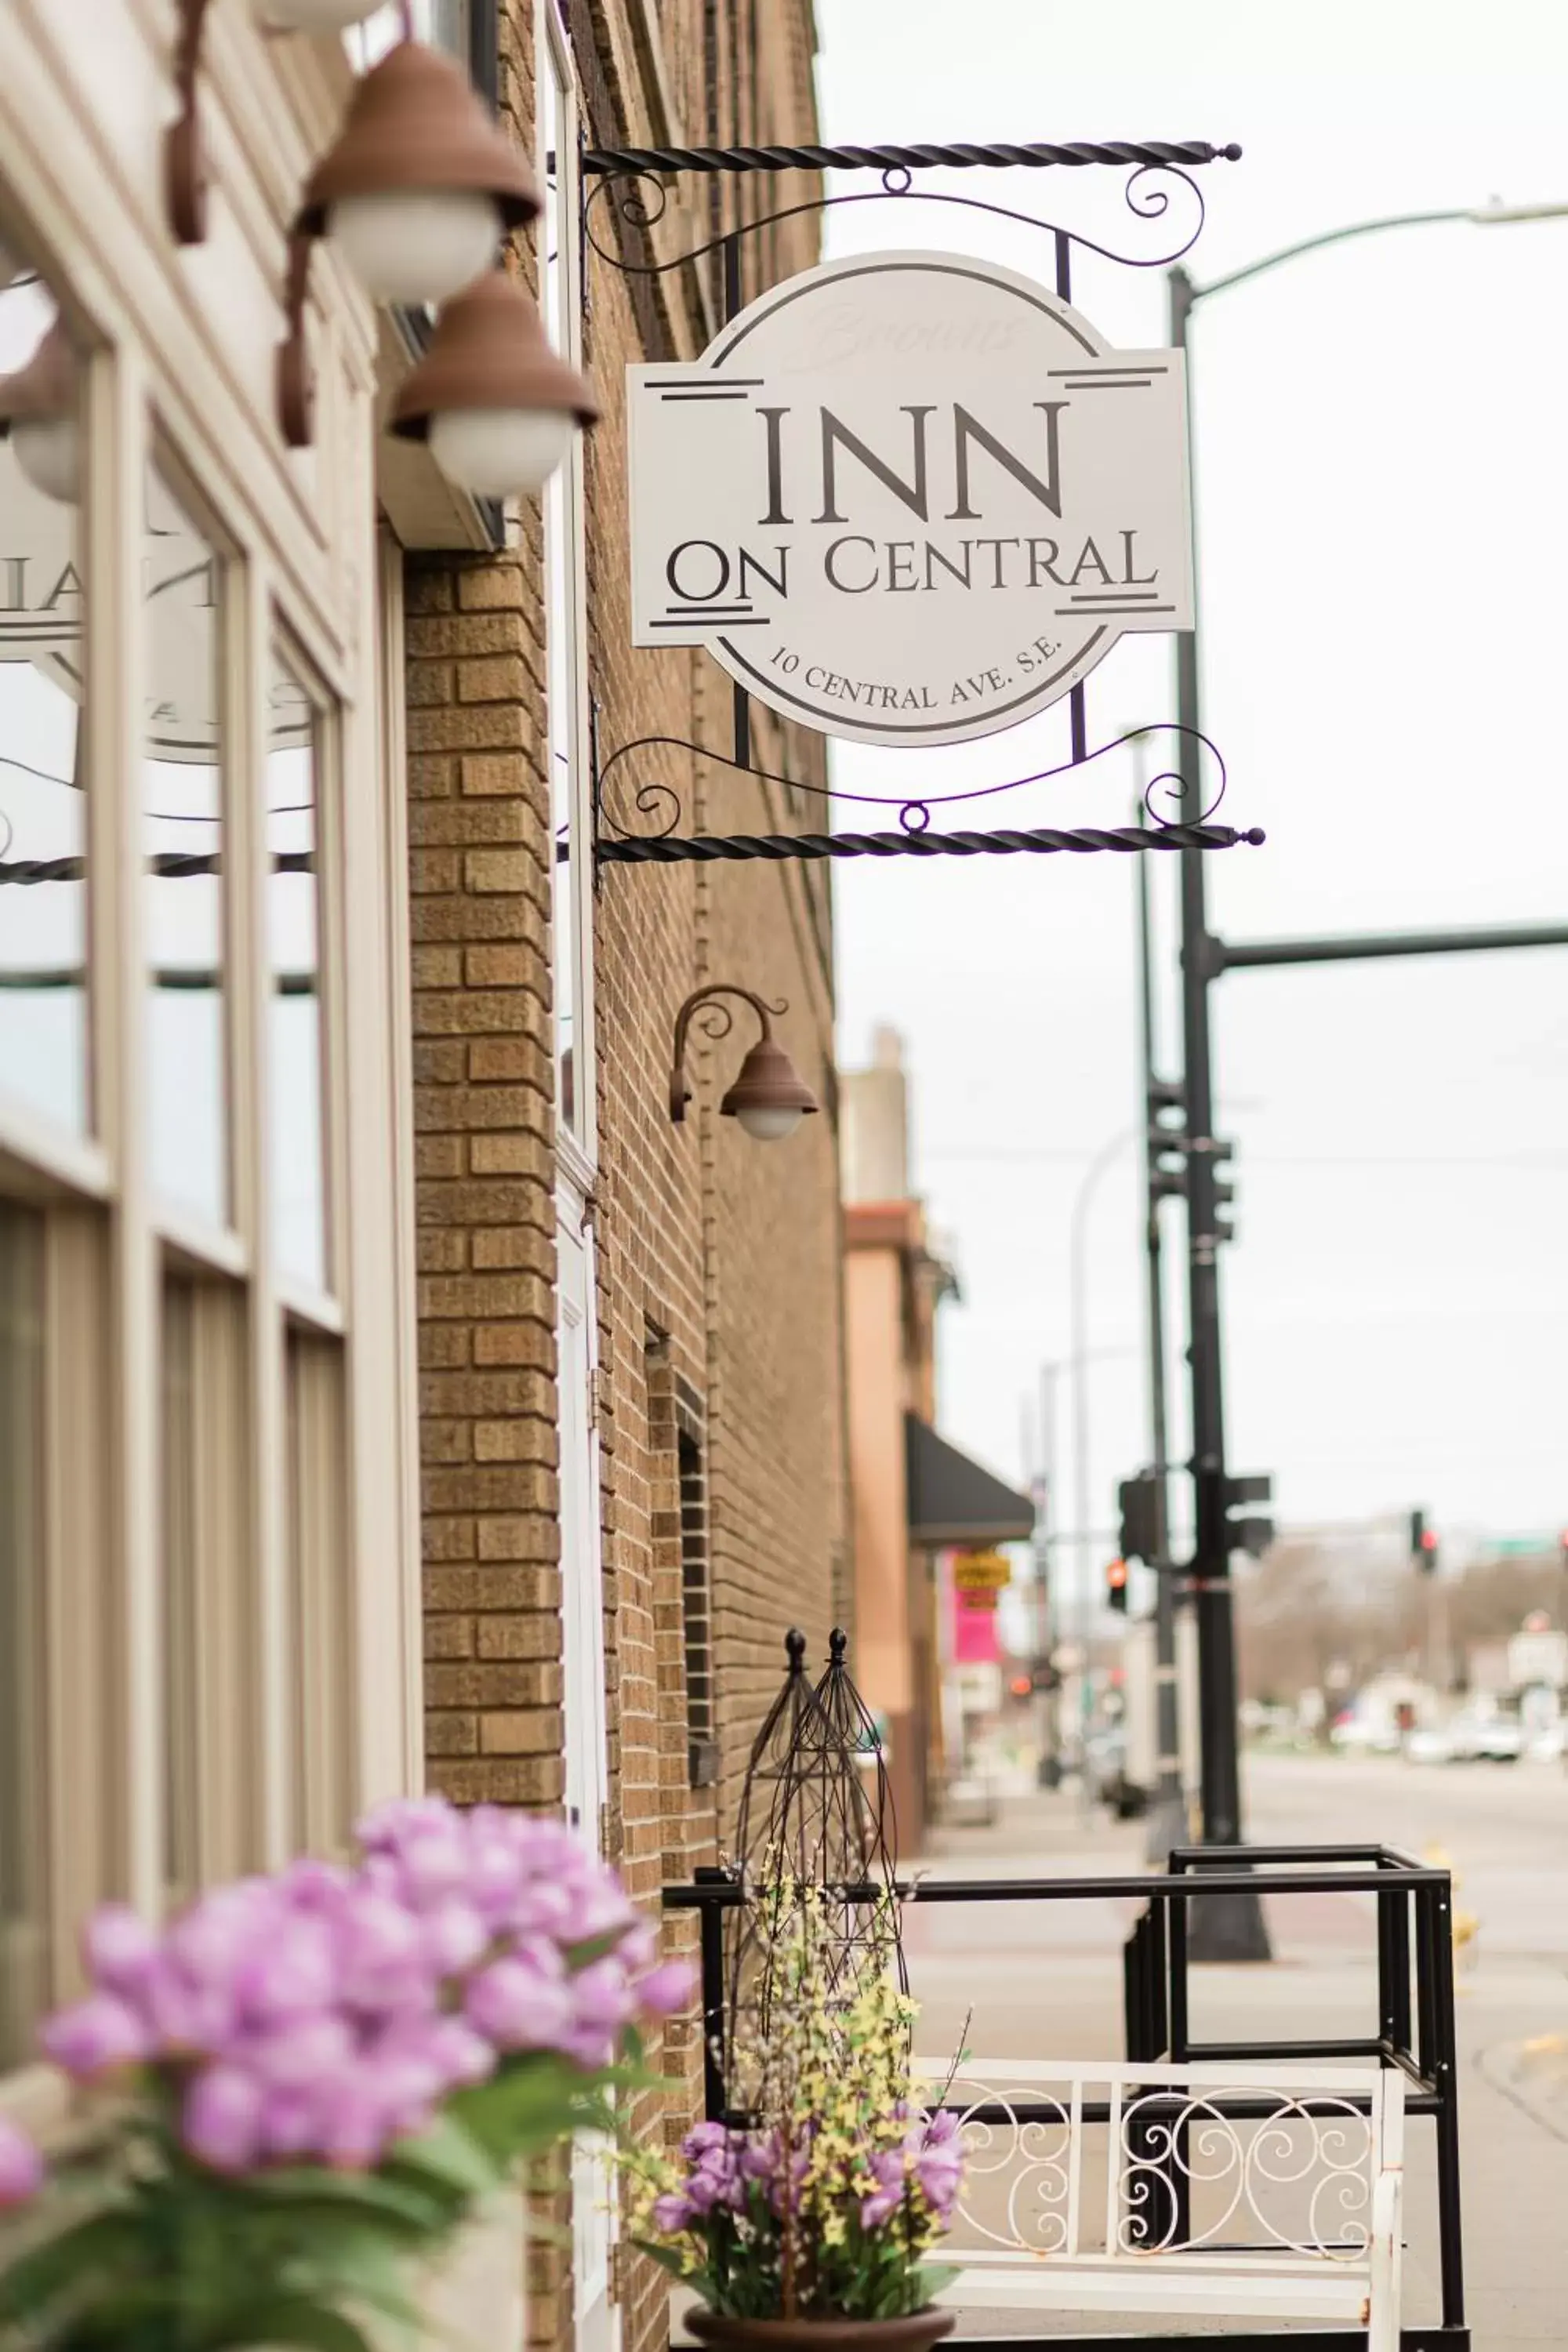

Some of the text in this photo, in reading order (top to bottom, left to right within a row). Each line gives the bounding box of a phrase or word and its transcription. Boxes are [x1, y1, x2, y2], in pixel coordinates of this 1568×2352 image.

[755, 401, 1072, 525] INN
[666, 530, 1160, 601] ON CENTRAL
[769, 636, 1062, 710] 10 CENTRAL AVE. S.E.
